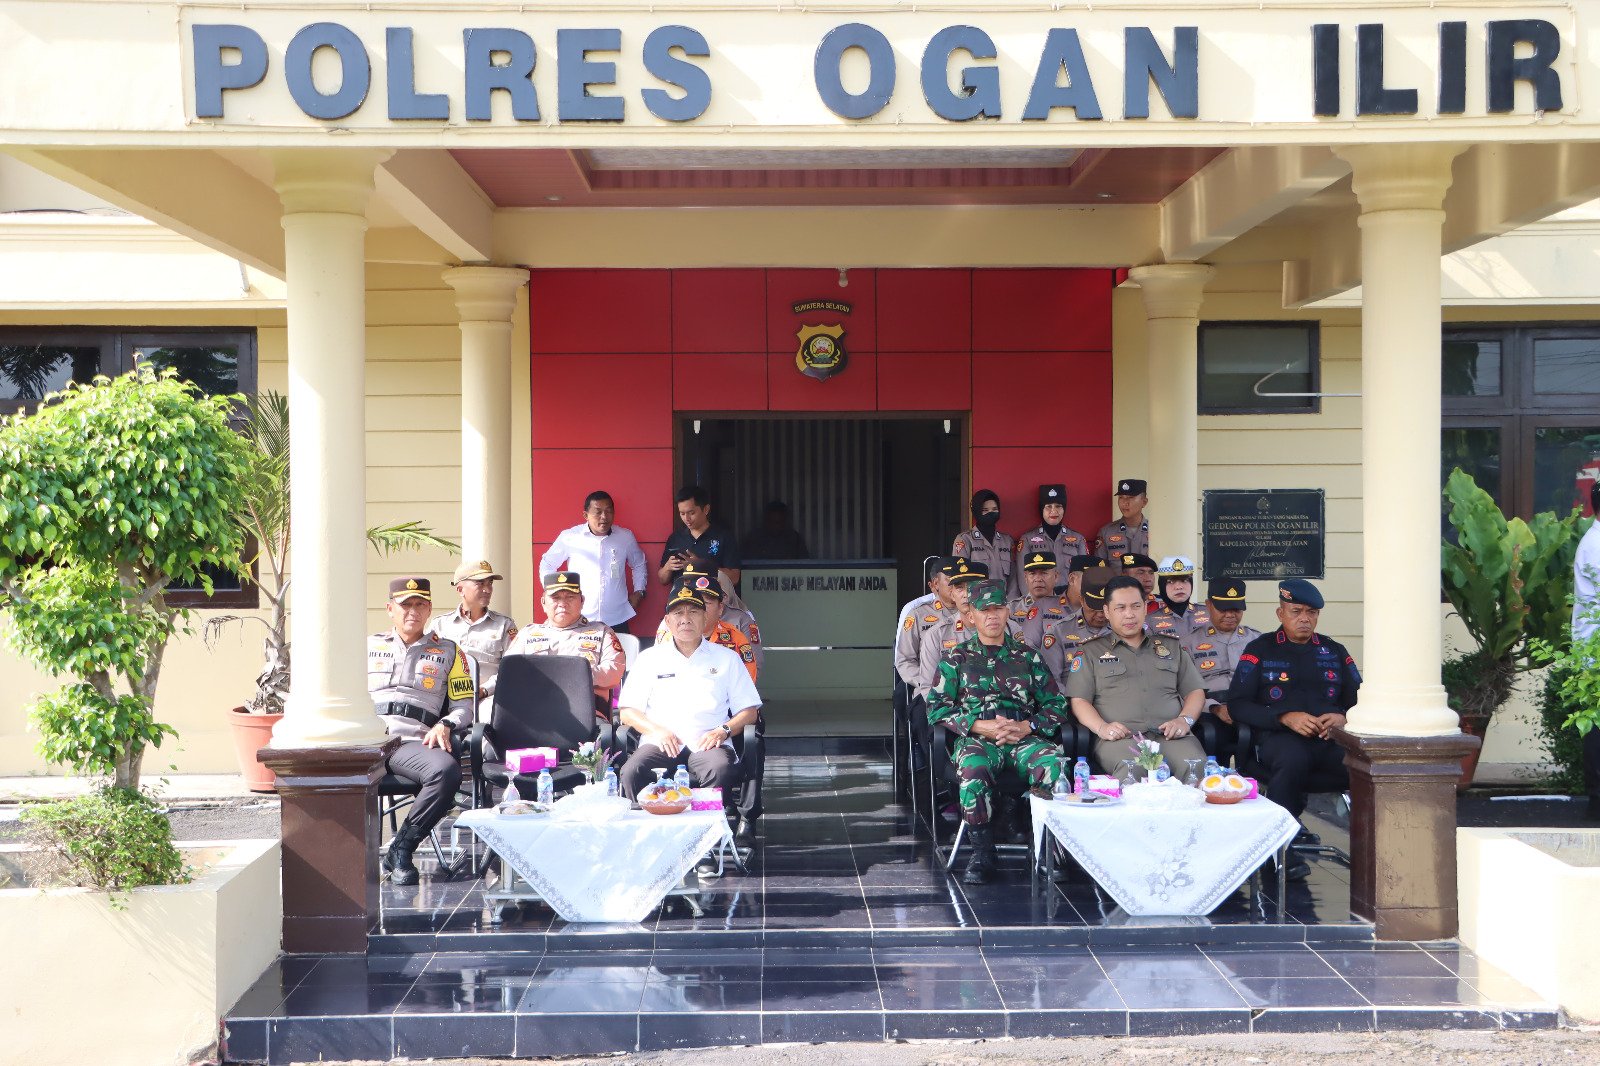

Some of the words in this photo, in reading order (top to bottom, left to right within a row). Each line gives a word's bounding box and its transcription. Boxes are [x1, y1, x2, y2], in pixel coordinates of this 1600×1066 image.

[192, 22, 712, 122] POLRES
[813, 22, 1199, 121] OGAN
[1312, 18, 1564, 119] ILIR
[794, 302, 825, 313] SUMATERA
[825, 302, 850, 313] SELATAN
[1208, 522, 1243, 530] GEDUNG
[1245, 522, 1276, 530] POLRES
[1276, 521, 1301, 529] OGAN
[1302, 521, 1319, 529] ILIR
[752, 576, 779, 591] KAMI
[781, 576, 804, 591] SIAP
[806, 576, 856, 591] MELAYANI
[858, 576, 887, 591] ANDA
[419, 654, 445, 664] POLRI
